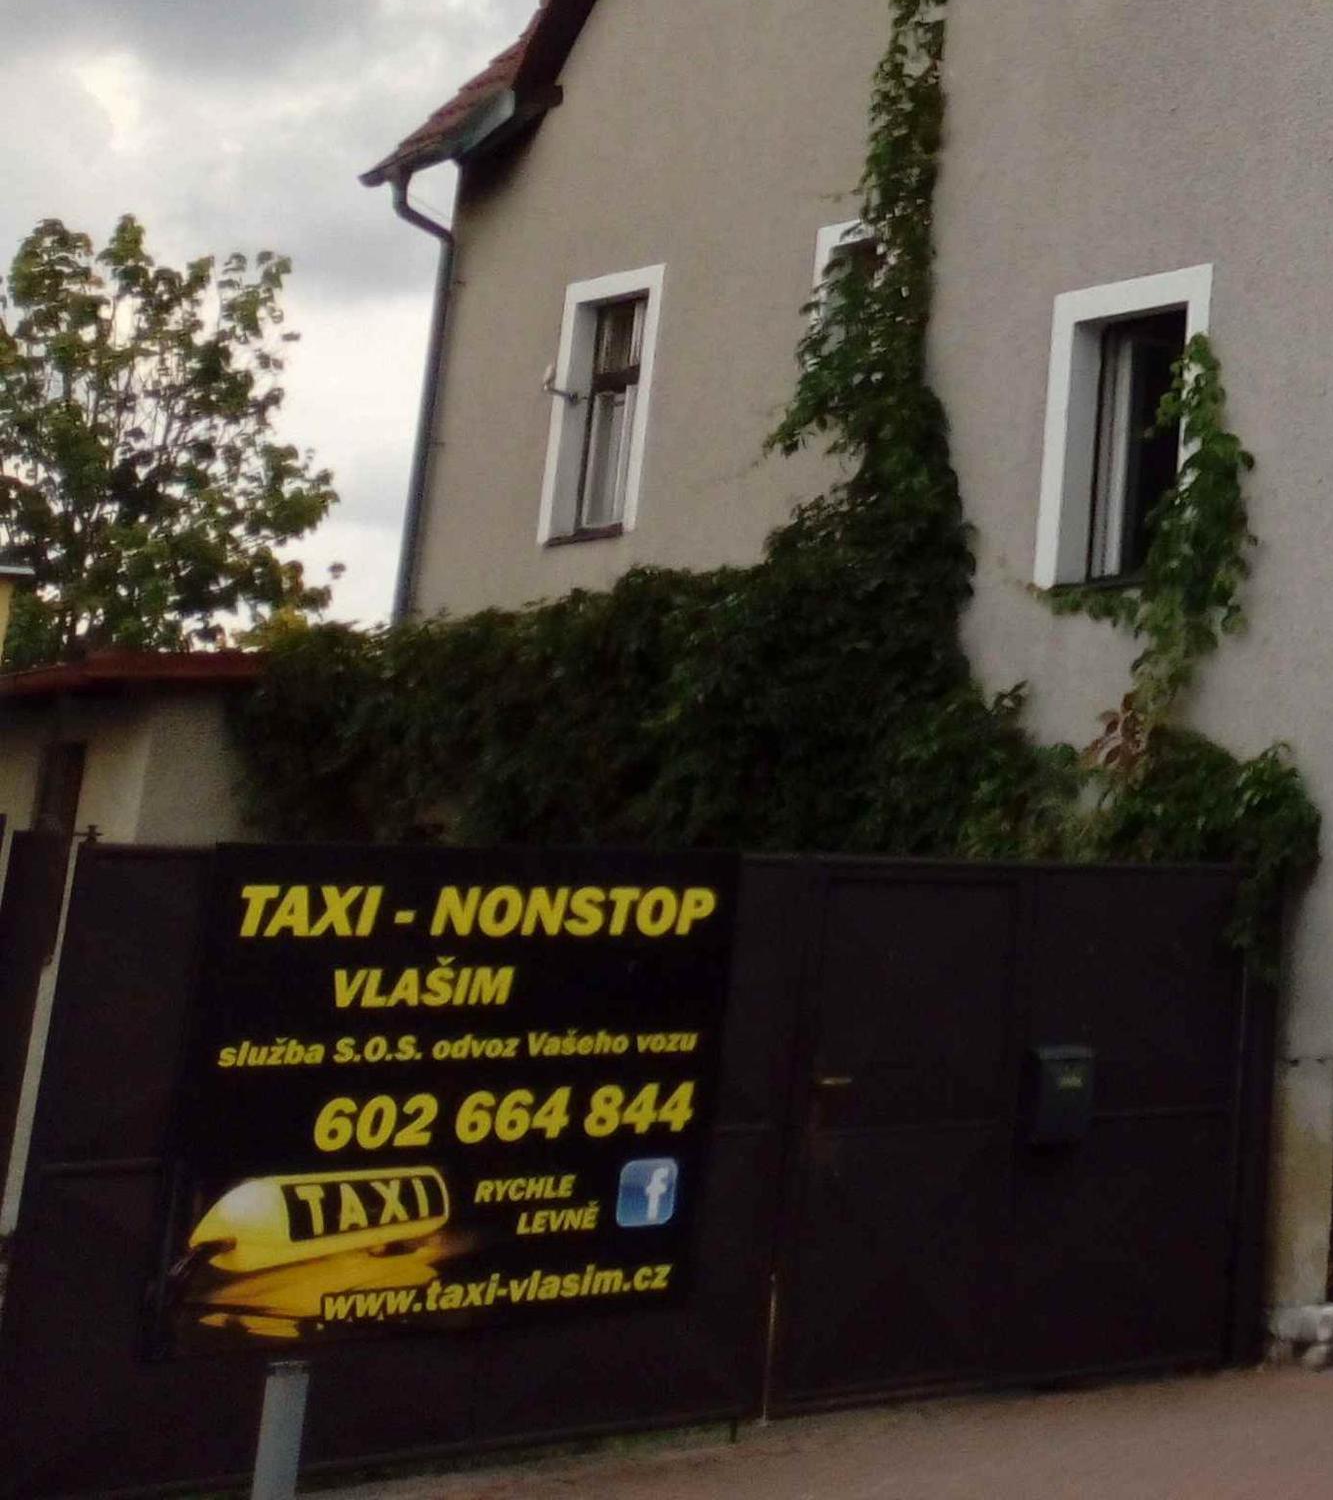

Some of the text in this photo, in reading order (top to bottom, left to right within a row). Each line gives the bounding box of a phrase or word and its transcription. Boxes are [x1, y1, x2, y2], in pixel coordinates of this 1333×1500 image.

[240, 884, 384, 937] TAXI
[430, 885, 716, 937] NONSTOP
[333, 956, 515, 1008] VLAŠIM
[218, 1028, 698, 1068] služba S.O.S. odvoz Vašeho vozu
[314, 1080, 695, 1152] 602 664 844
[295, 1177, 429, 1236] TAXI
[474, 1174, 577, 1204] RYCHLE
[516, 1201, 600, 1235] LEVNĚ
[322, 1263, 673, 1321] www.taxi-vlasim.cz
